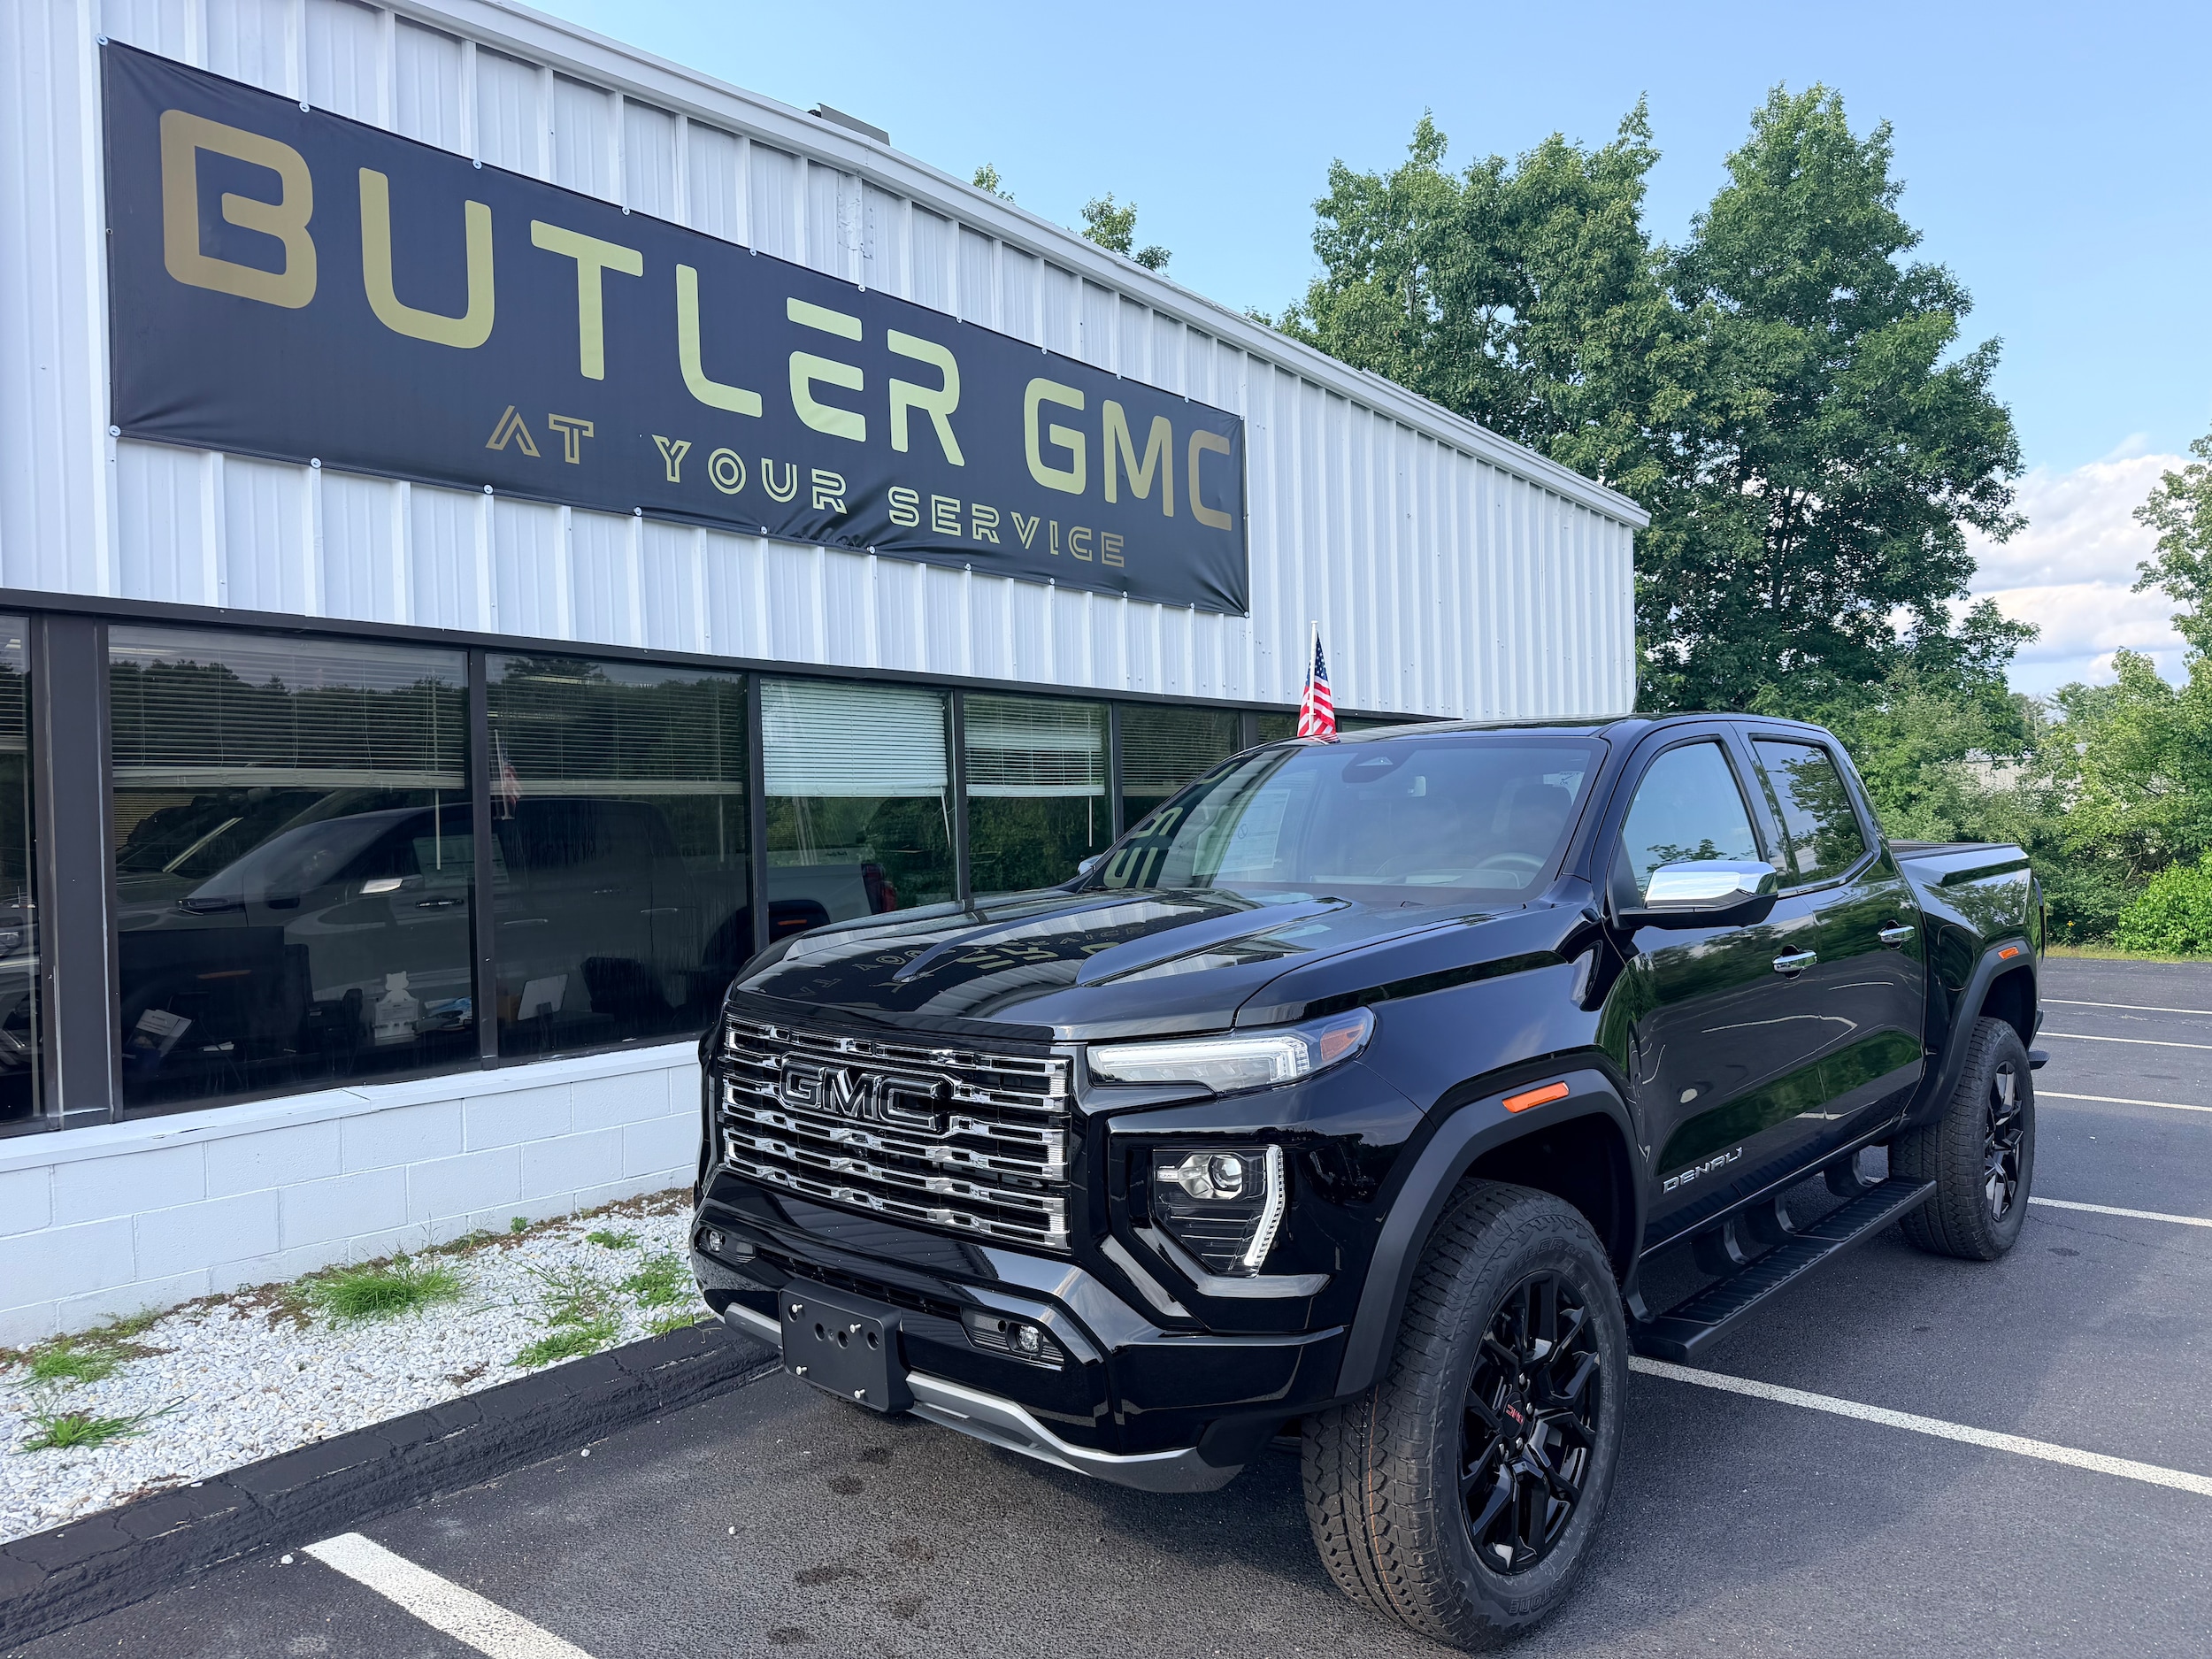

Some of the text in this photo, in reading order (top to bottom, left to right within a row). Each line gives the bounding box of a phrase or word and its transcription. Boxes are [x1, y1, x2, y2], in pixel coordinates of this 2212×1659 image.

[160, 109, 1233, 531] BUTLER GMC
[486, 405, 1125, 567] AT YOUR SERVICE
[781, 1059, 945, 1133] GMC
[1663, 1147, 1743, 1194] DENALI
[1505, 1403, 1524, 1425] GMC
